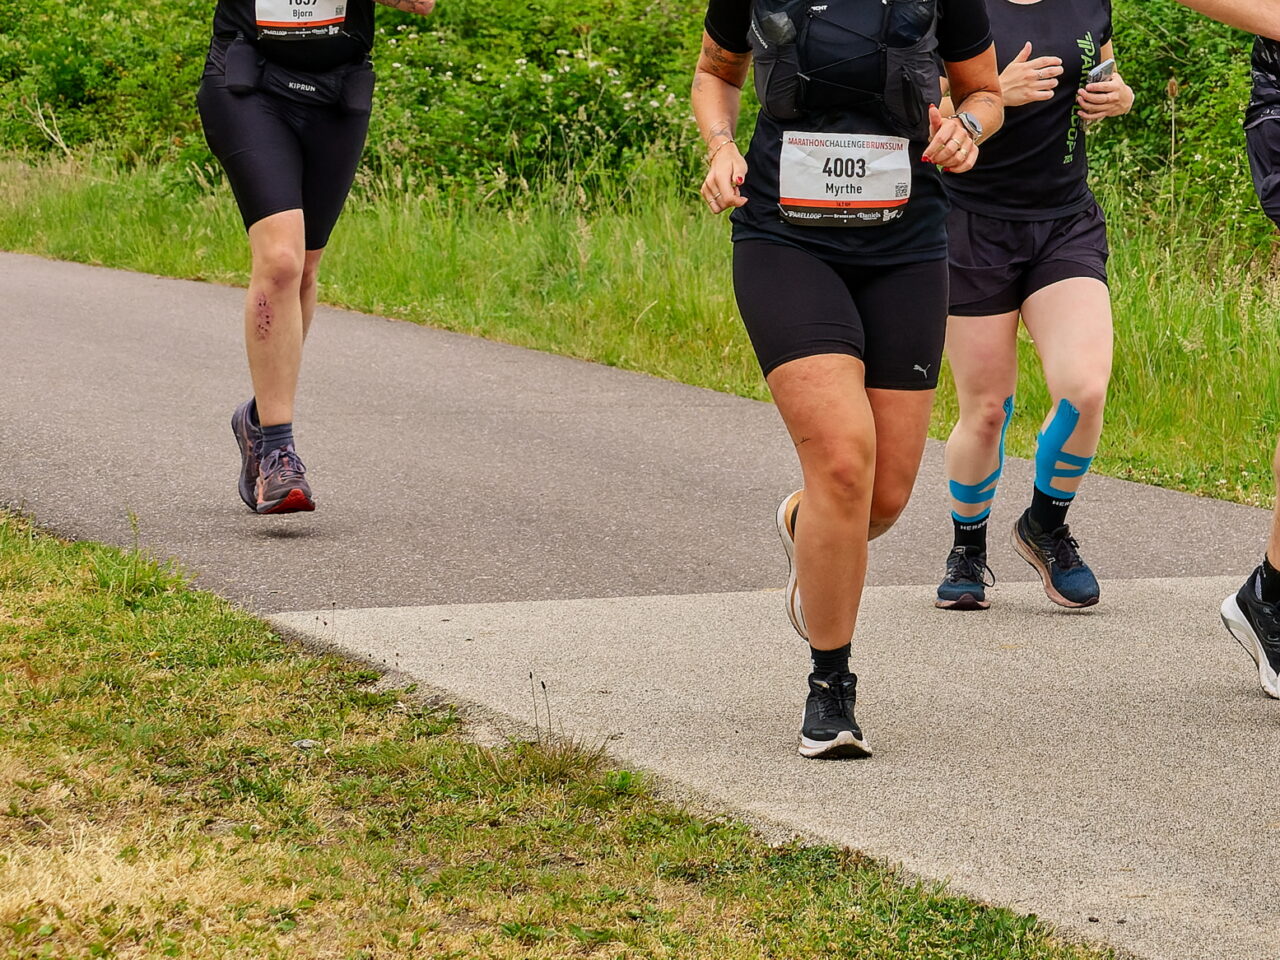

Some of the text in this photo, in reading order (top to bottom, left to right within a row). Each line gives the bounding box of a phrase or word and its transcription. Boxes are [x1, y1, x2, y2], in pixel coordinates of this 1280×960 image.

[293, 10, 312, 19] Bjorn
[289, 82, 316, 92] KIPRUN
[788, 138, 904, 151] MARATHONCHALLENGEBRUNSSUM
[823, 158, 866, 178] 4003
[826, 183, 862, 196] Myrthe
